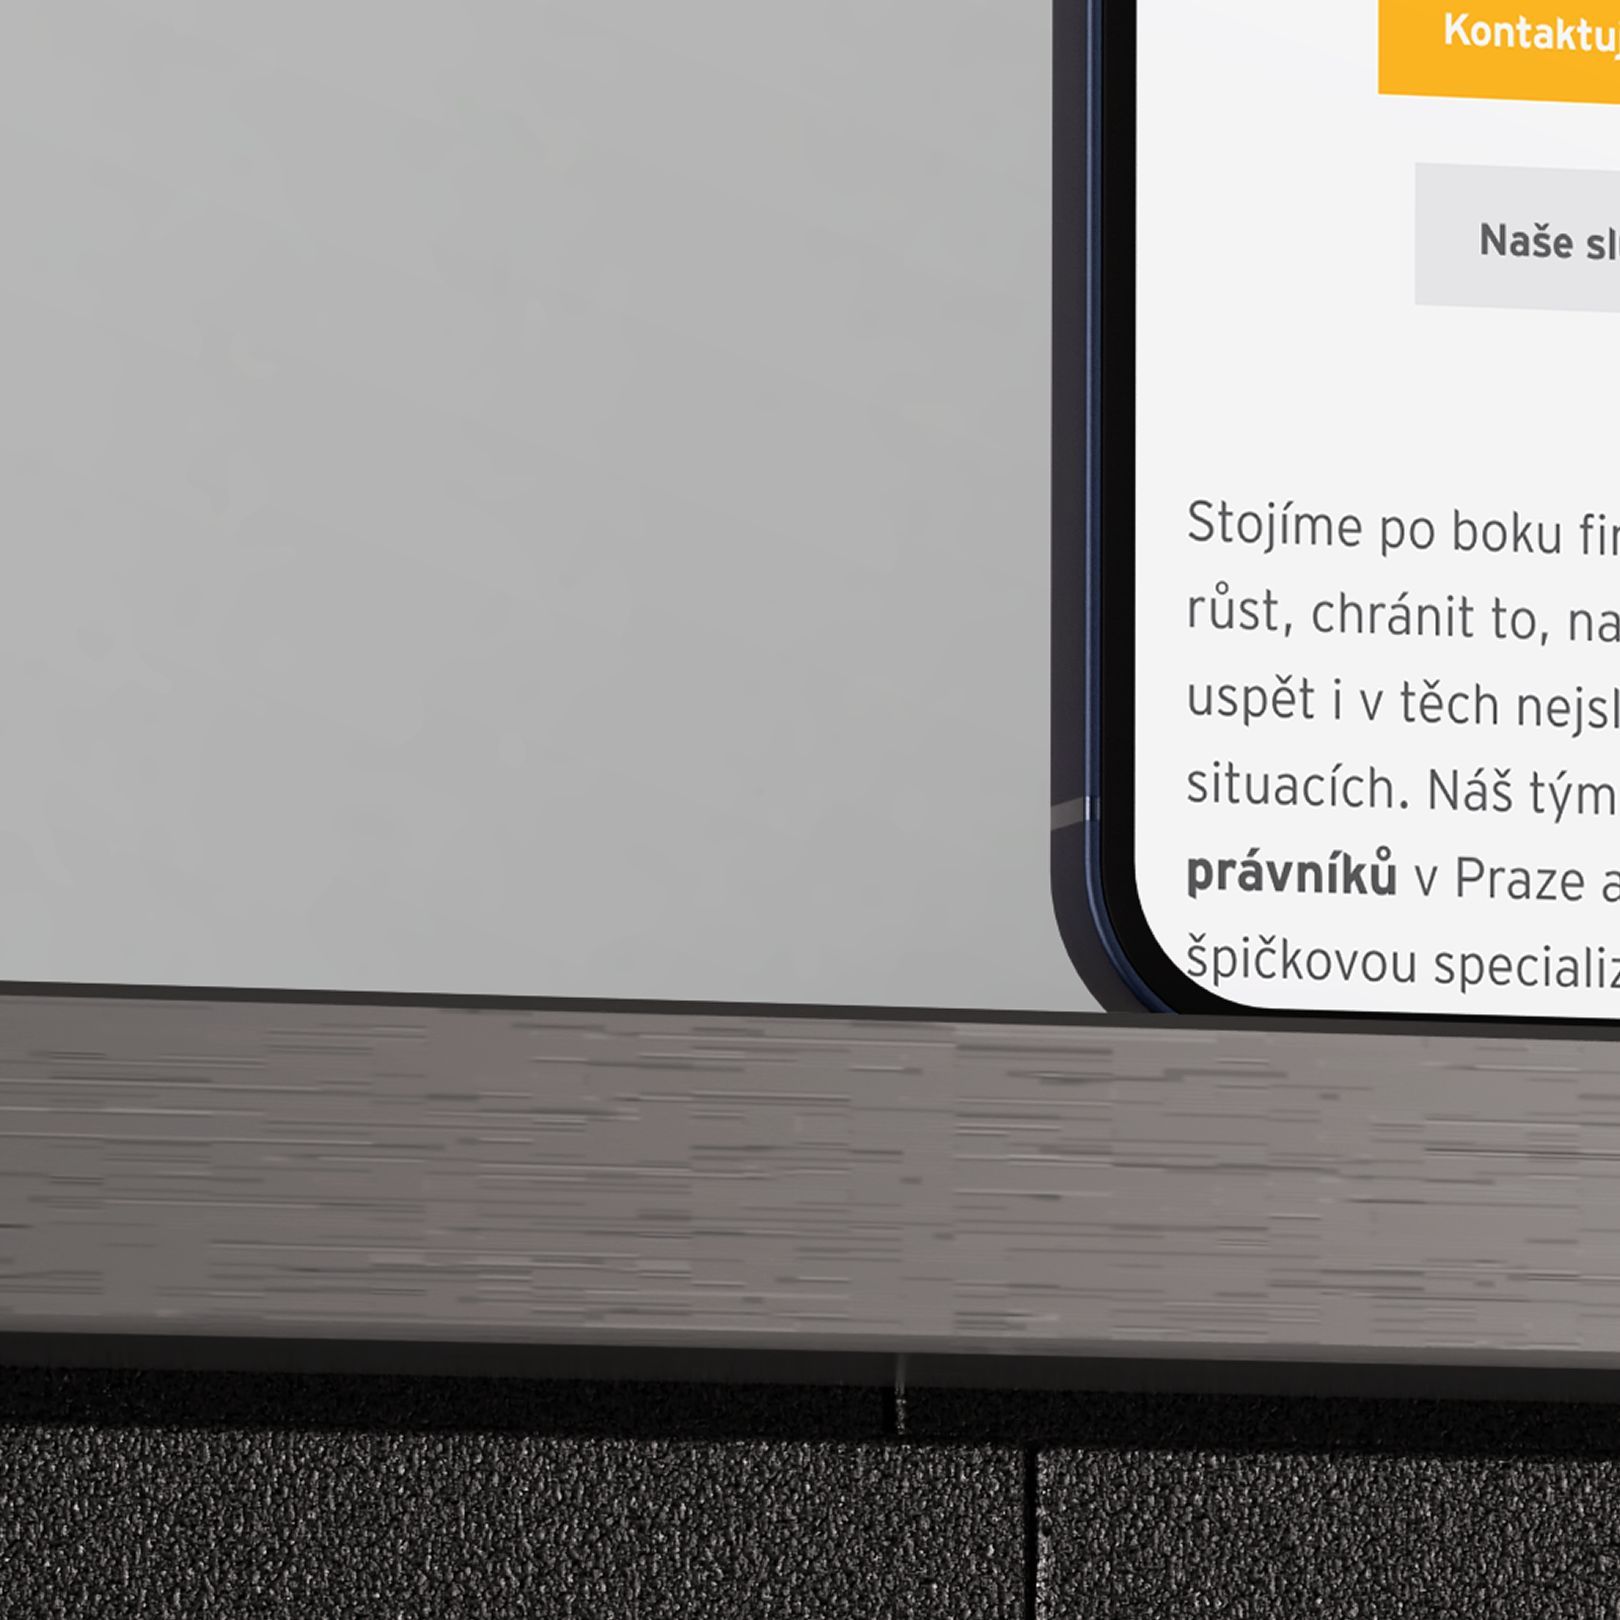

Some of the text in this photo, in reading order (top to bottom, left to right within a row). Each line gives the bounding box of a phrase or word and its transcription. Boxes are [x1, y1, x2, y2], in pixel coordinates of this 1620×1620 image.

[1480, 222, 1574, 259] Naše
[1188, 499, 1362, 555] Stojíme
[1381, 516, 1435, 558] po
[1454, 508, 1561, 555] boku
[1189, 580, 1292, 638] růst,
[1312, 591, 1474, 638] chránit
[1491, 596, 1548, 647] to,
[1569, 609, 1620, 643] na
[1188, 673, 1315, 727] uspět
[1334, 677, 1341, 720] i
[1359, 689, 1384, 721] v
[1400, 678, 1498, 726] těch
[1187, 760, 1409, 810] situacích.
[1429, 767, 1513, 813] Náš
[1529, 769, 1616, 824] tým
[1187, 845, 1397, 900] právníků
[1414, 865, 1438, 897] v
[1457, 856, 1585, 902] Praze
[1187, 932, 1416, 988] špičkovou
